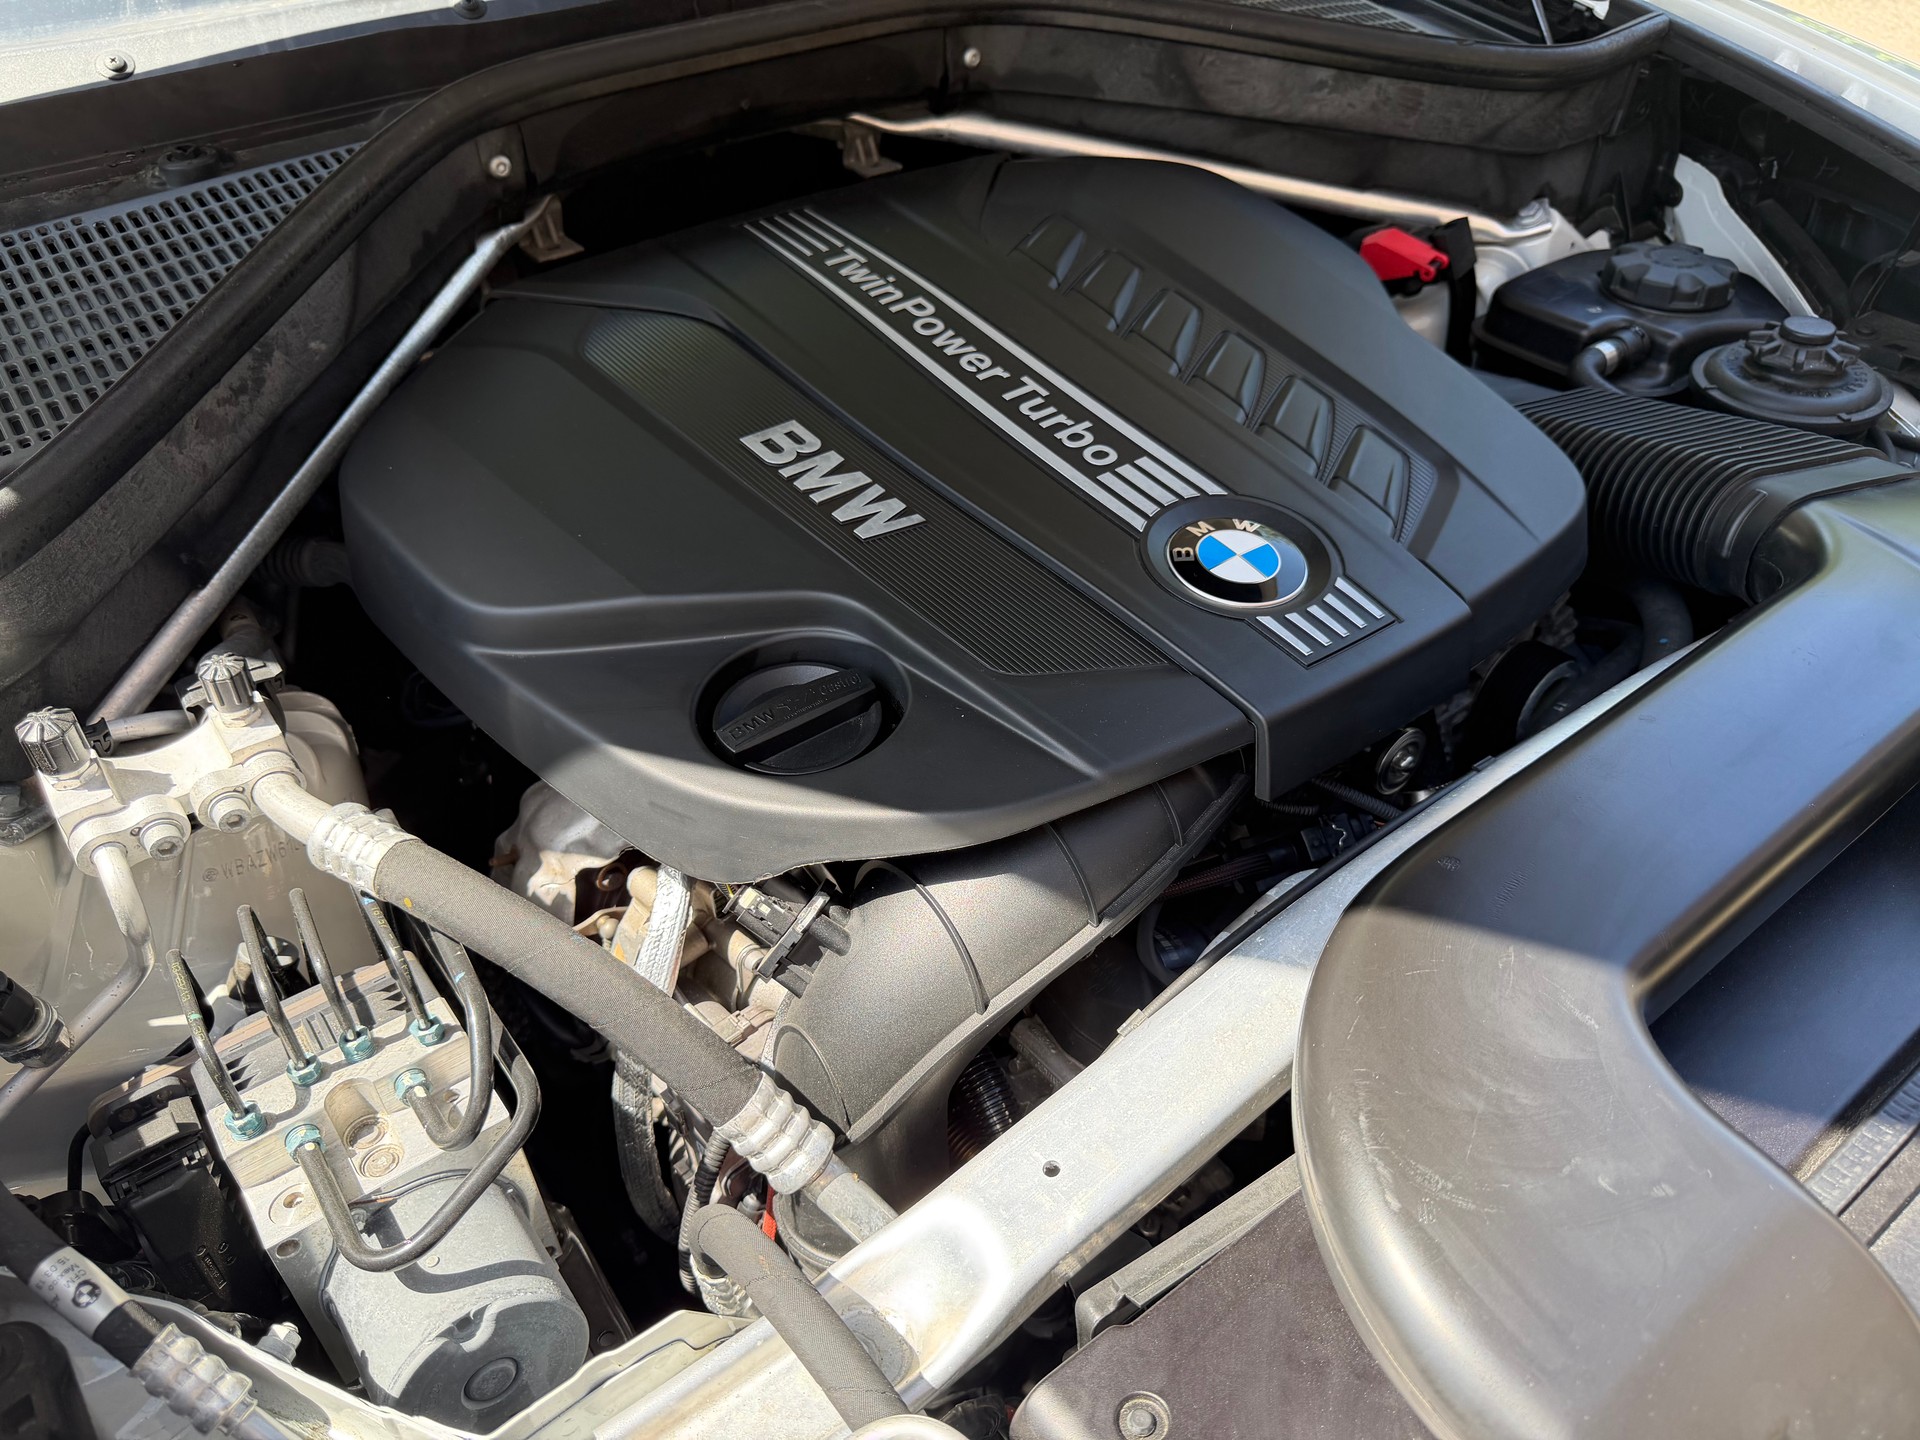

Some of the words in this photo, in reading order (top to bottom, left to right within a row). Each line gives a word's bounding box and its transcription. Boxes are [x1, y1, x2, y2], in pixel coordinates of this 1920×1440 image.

[822, 246, 1010, 382] TwinPower
[1002, 376, 1119, 466] Turbo
[739, 418, 926, 541] BMW
[729, 708, 776, 740] BMW
